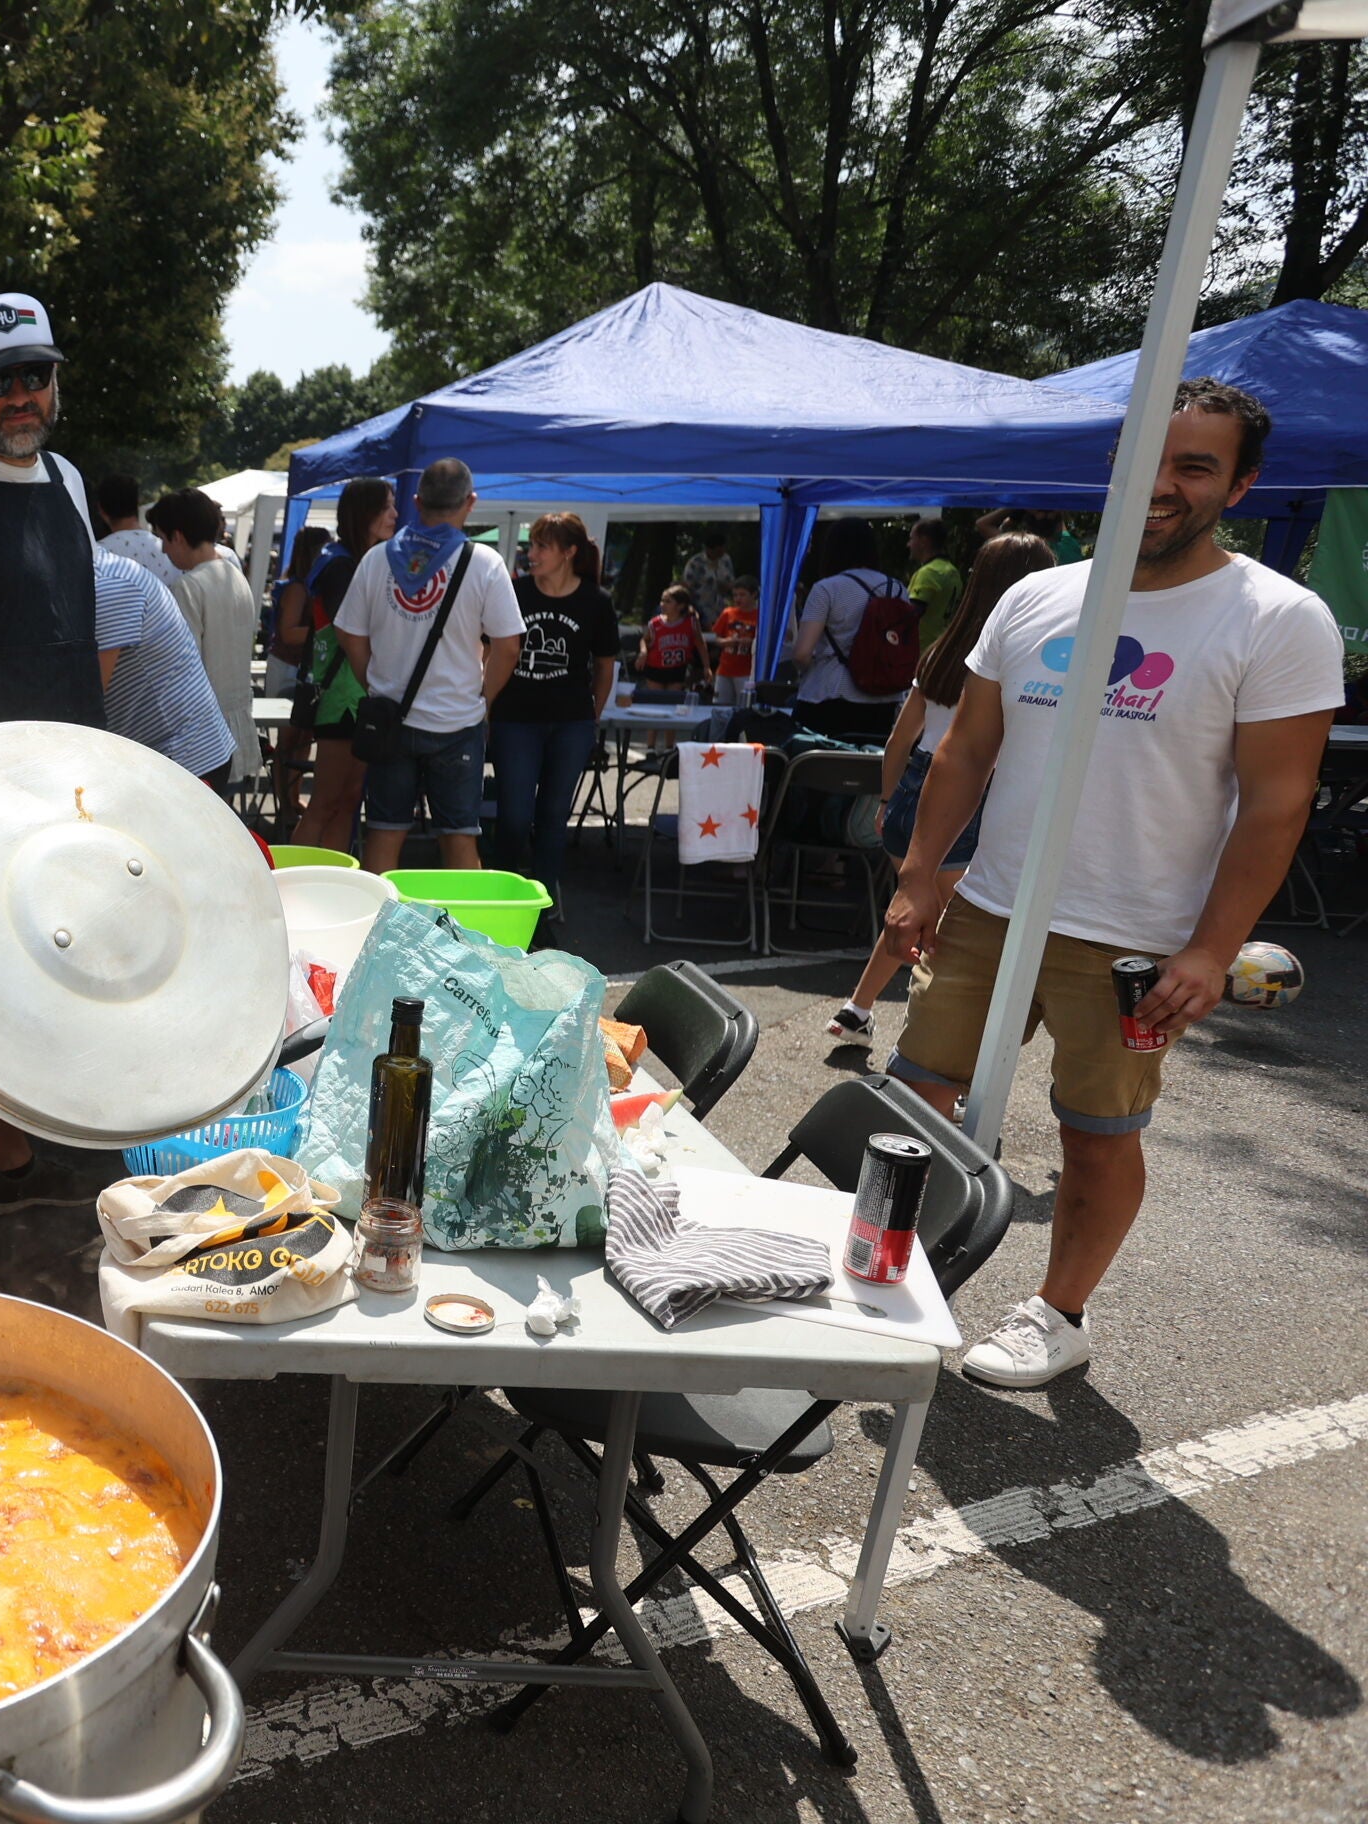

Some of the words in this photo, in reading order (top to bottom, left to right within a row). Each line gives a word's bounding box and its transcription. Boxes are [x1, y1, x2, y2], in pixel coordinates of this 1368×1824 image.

[524, 611, 554, 624] IESTA
[558, 613, 580, 632] TIME
[664, 648, 686, 666] 23
[443, 977, 504, 1039] Carrefour
[163, 1249, 264, 1277] ERTOKO
[205, 1284, 234, 1296] Kalea
[205, 1299, 230, 1314] 622
[234, 1301, 260, 1315] 675
